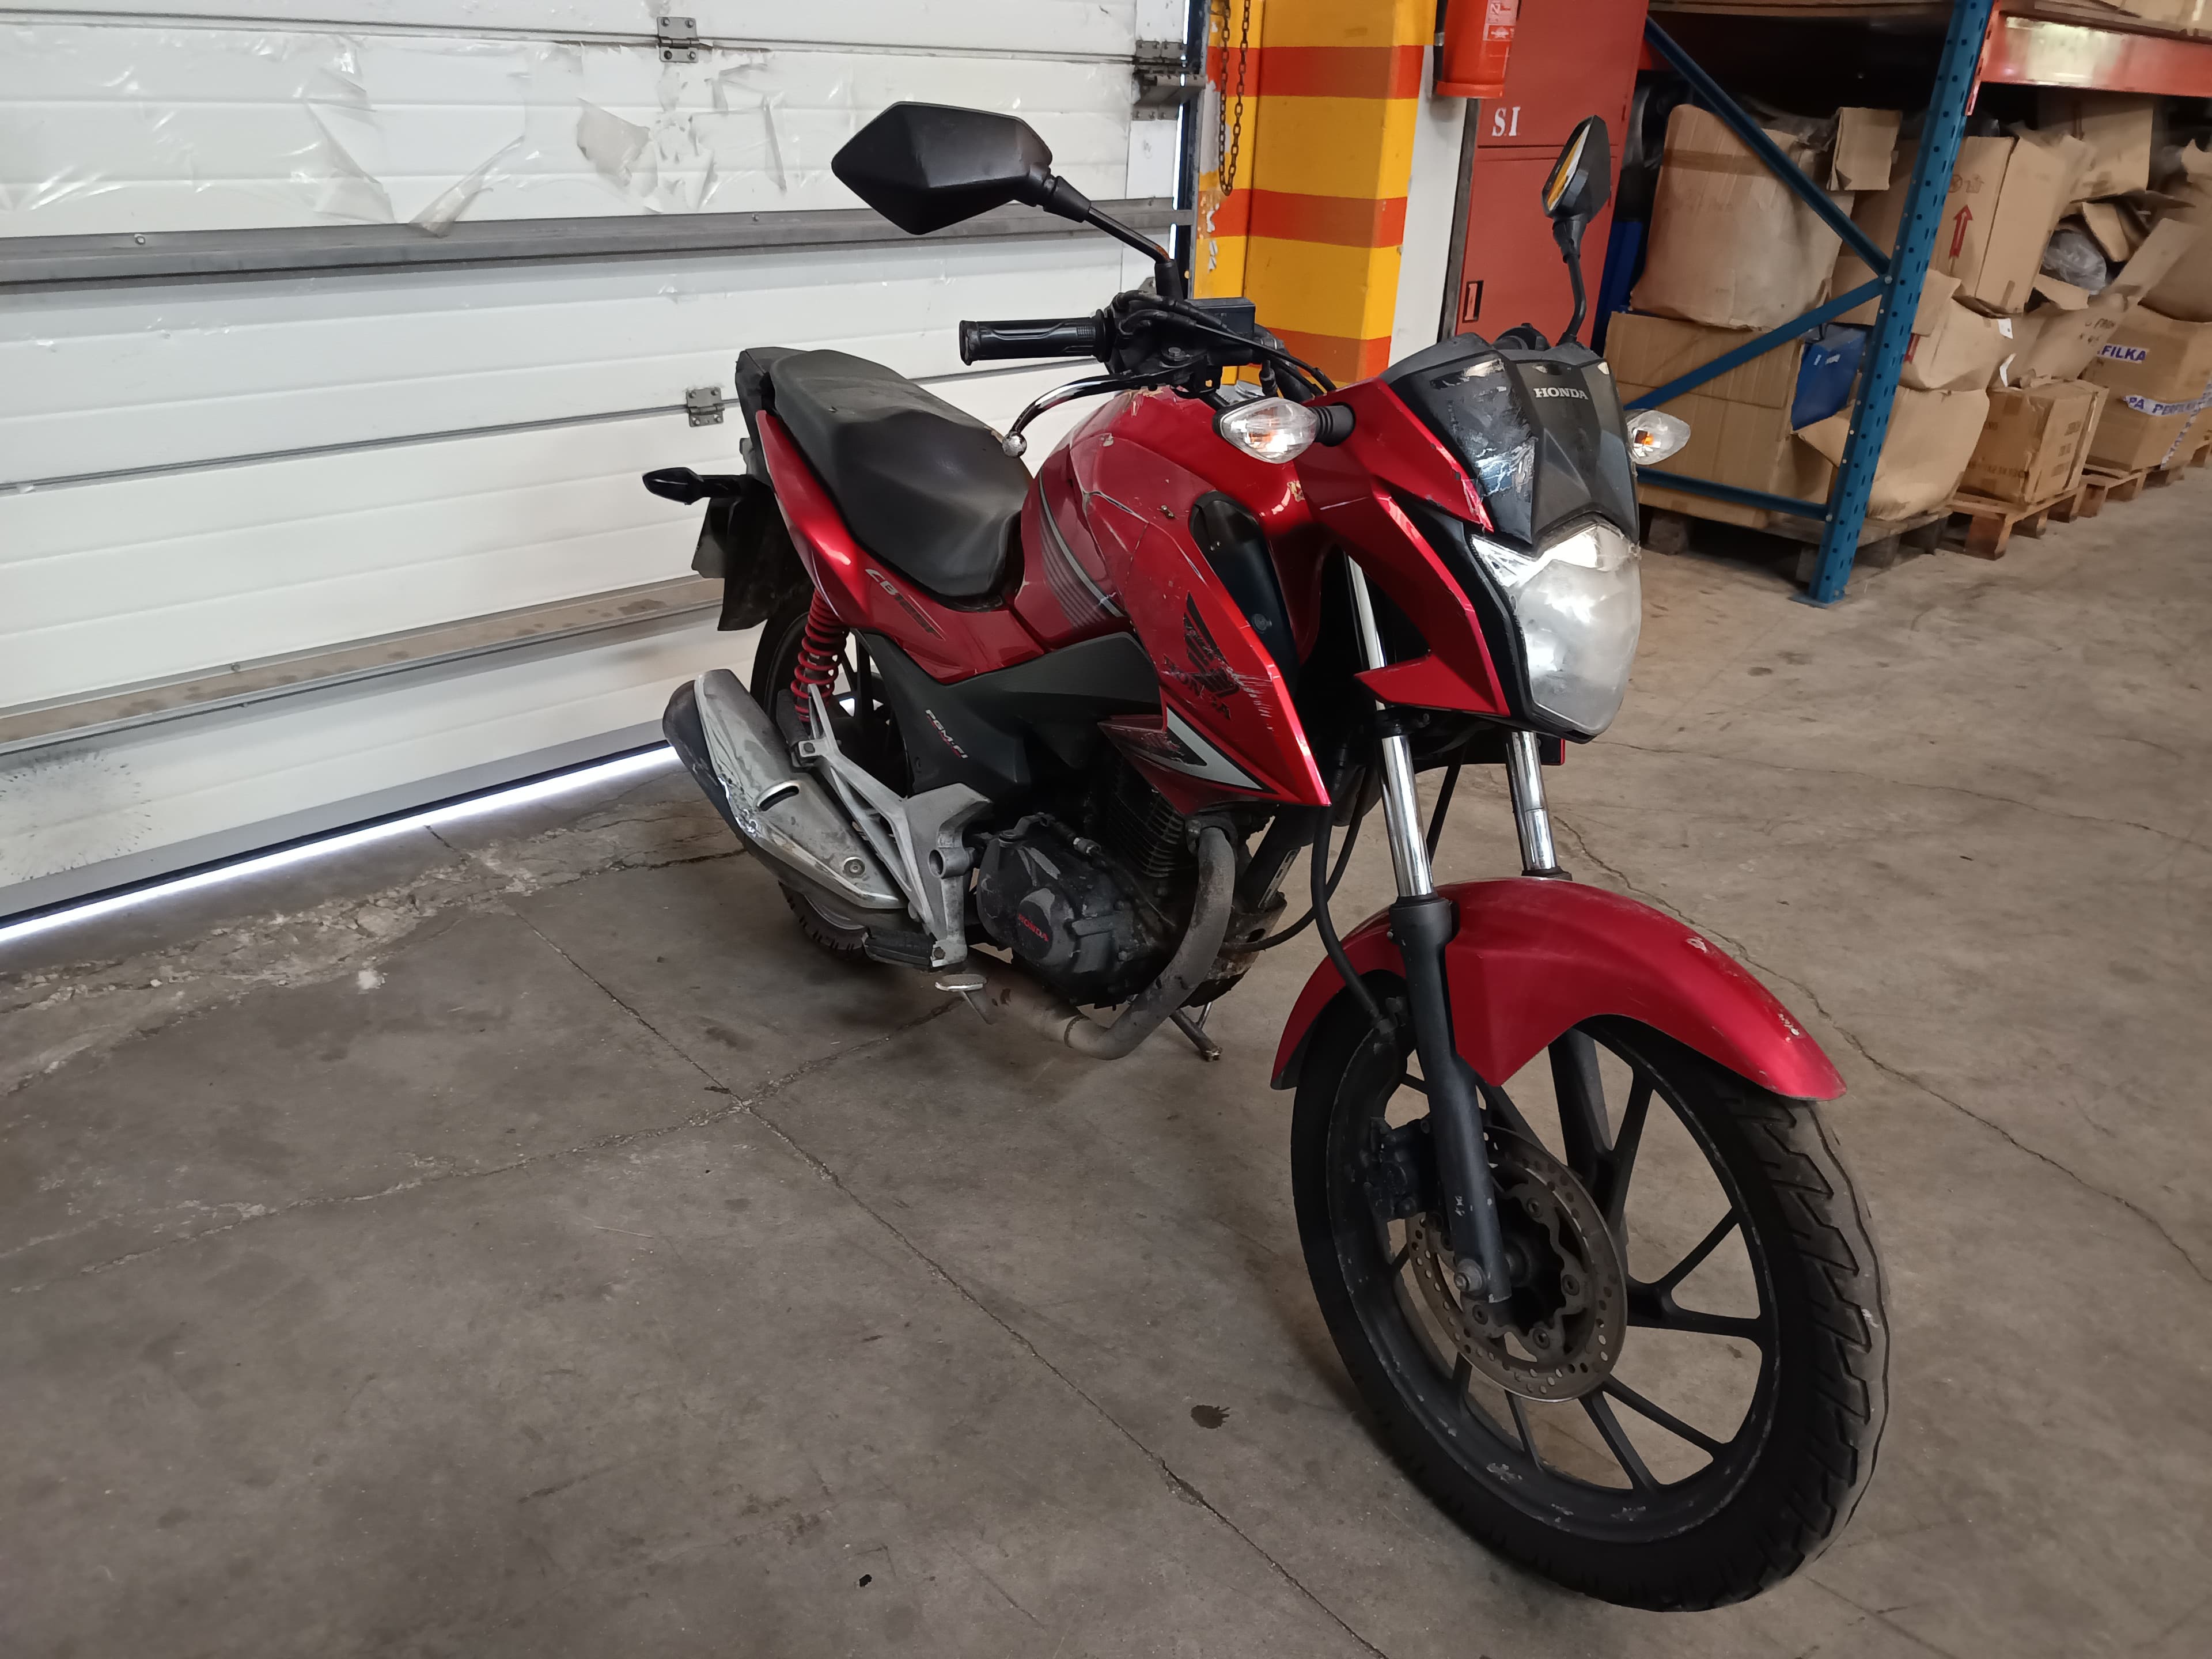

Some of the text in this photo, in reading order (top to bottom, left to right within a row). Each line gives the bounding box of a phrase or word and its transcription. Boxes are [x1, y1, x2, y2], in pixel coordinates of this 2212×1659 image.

[2097, 345, 2146, 361] FILKA
[1533, 387, 1589, 400] HONDA
[1163, 653, 1232, 720] ONA
[1018, 913, 1049, 941] HONDA
